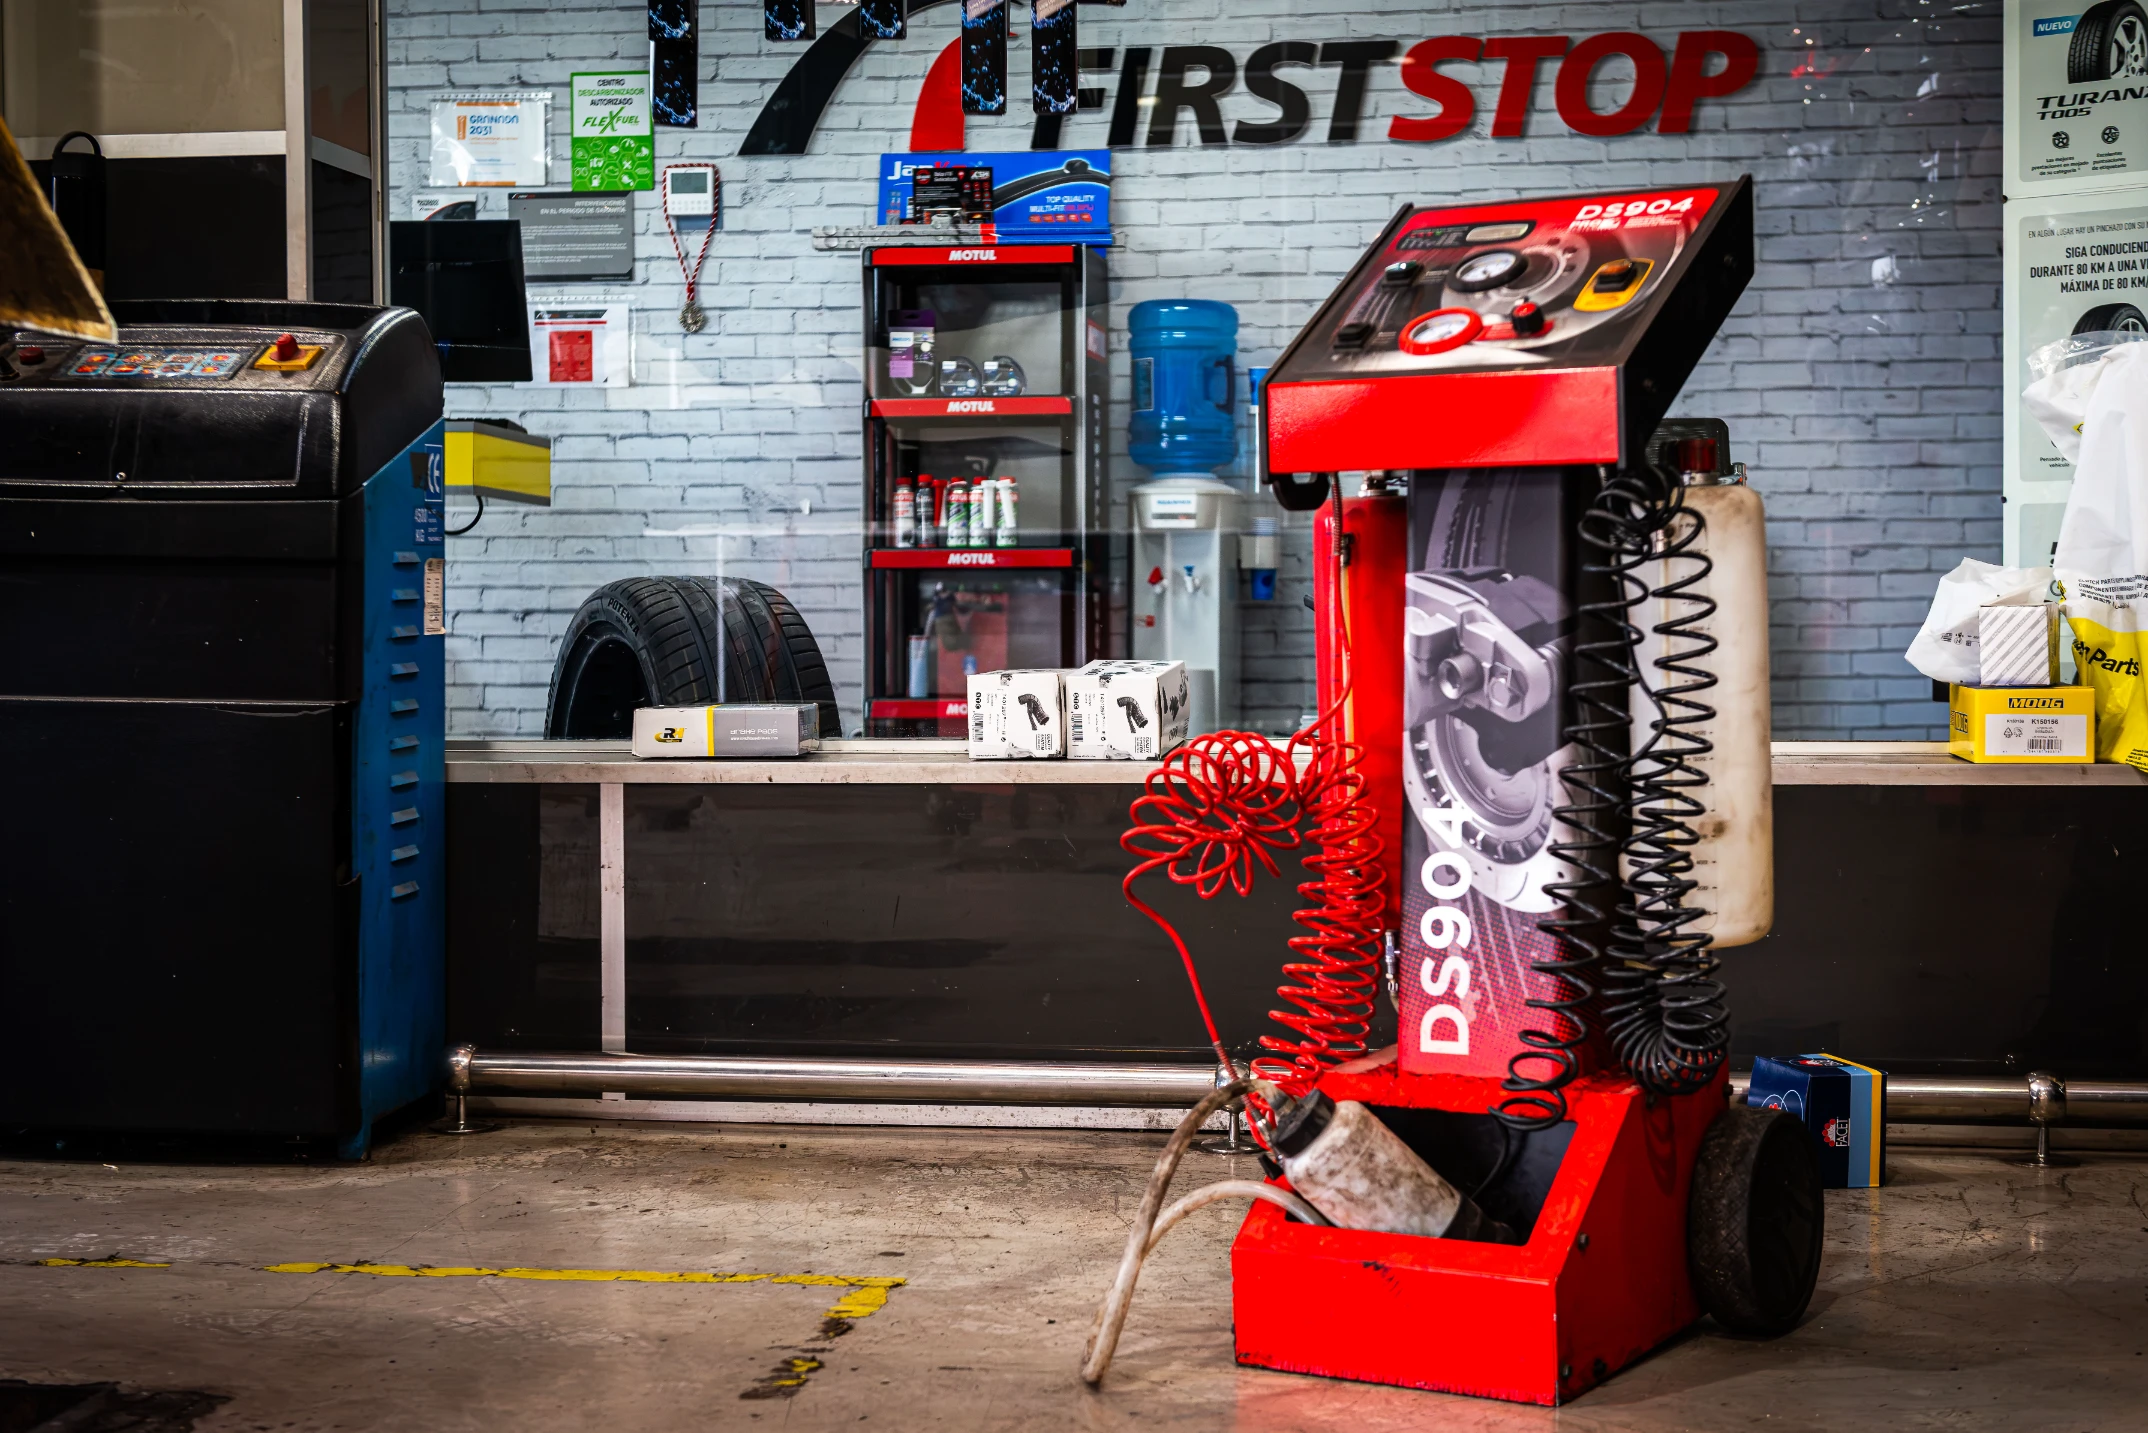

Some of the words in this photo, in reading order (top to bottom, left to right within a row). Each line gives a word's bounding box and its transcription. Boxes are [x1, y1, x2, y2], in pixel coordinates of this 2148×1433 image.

[2037, 20, 2072, 32] NUEVO
[597, 79, 626, 87] CENTRO
[578, 88, 646, 97] DESCARBONIZADOR
[590, 98, 634, 106] AUTORIZADO
[2036, 107, 2092, 120] T005
[469, 126, 492, 136] 2031
[1575, 197, 1694, 221] DS904
[2029, 230, 2036, 238] EN
[2037, 228, 2055, 238] ALGÚN
[2075, 226, 2086, 234] HAY
[2087, 225, 2095, 233] UN
[2096, 223, 2123, 232] PINCHAZO
[2124, 222, 2136, 230] CON
[2137, 221, 2145, 229] SU
[949, 250, 997, 261] MOTUL
[2065, 246, 2088, 258] SIGA
[2030, 264, 2074, 278] DURANTE
[2076, 263, 2088, 275] 80
[2090, 262, 2105, 274] KM
[2108, 261, 2115, 273] A
[2117, 259, 2138, 272] UNA
[2060, 279, 2100, 293] MÁXIMA
[2102, 278, 2114, 290] DE
[2117, 277, 2128, 289] 80
[947, 401, 995, 412] MOTUL
[948, 553, 995, 564] MOTUL
[2087, 648, 2139, 676] Parts
[2009, 698, 2063, 708] MOOG
[1420, 803, 1474, 1056] DS904
[1836, 1117, 1848, 1147] FACET
